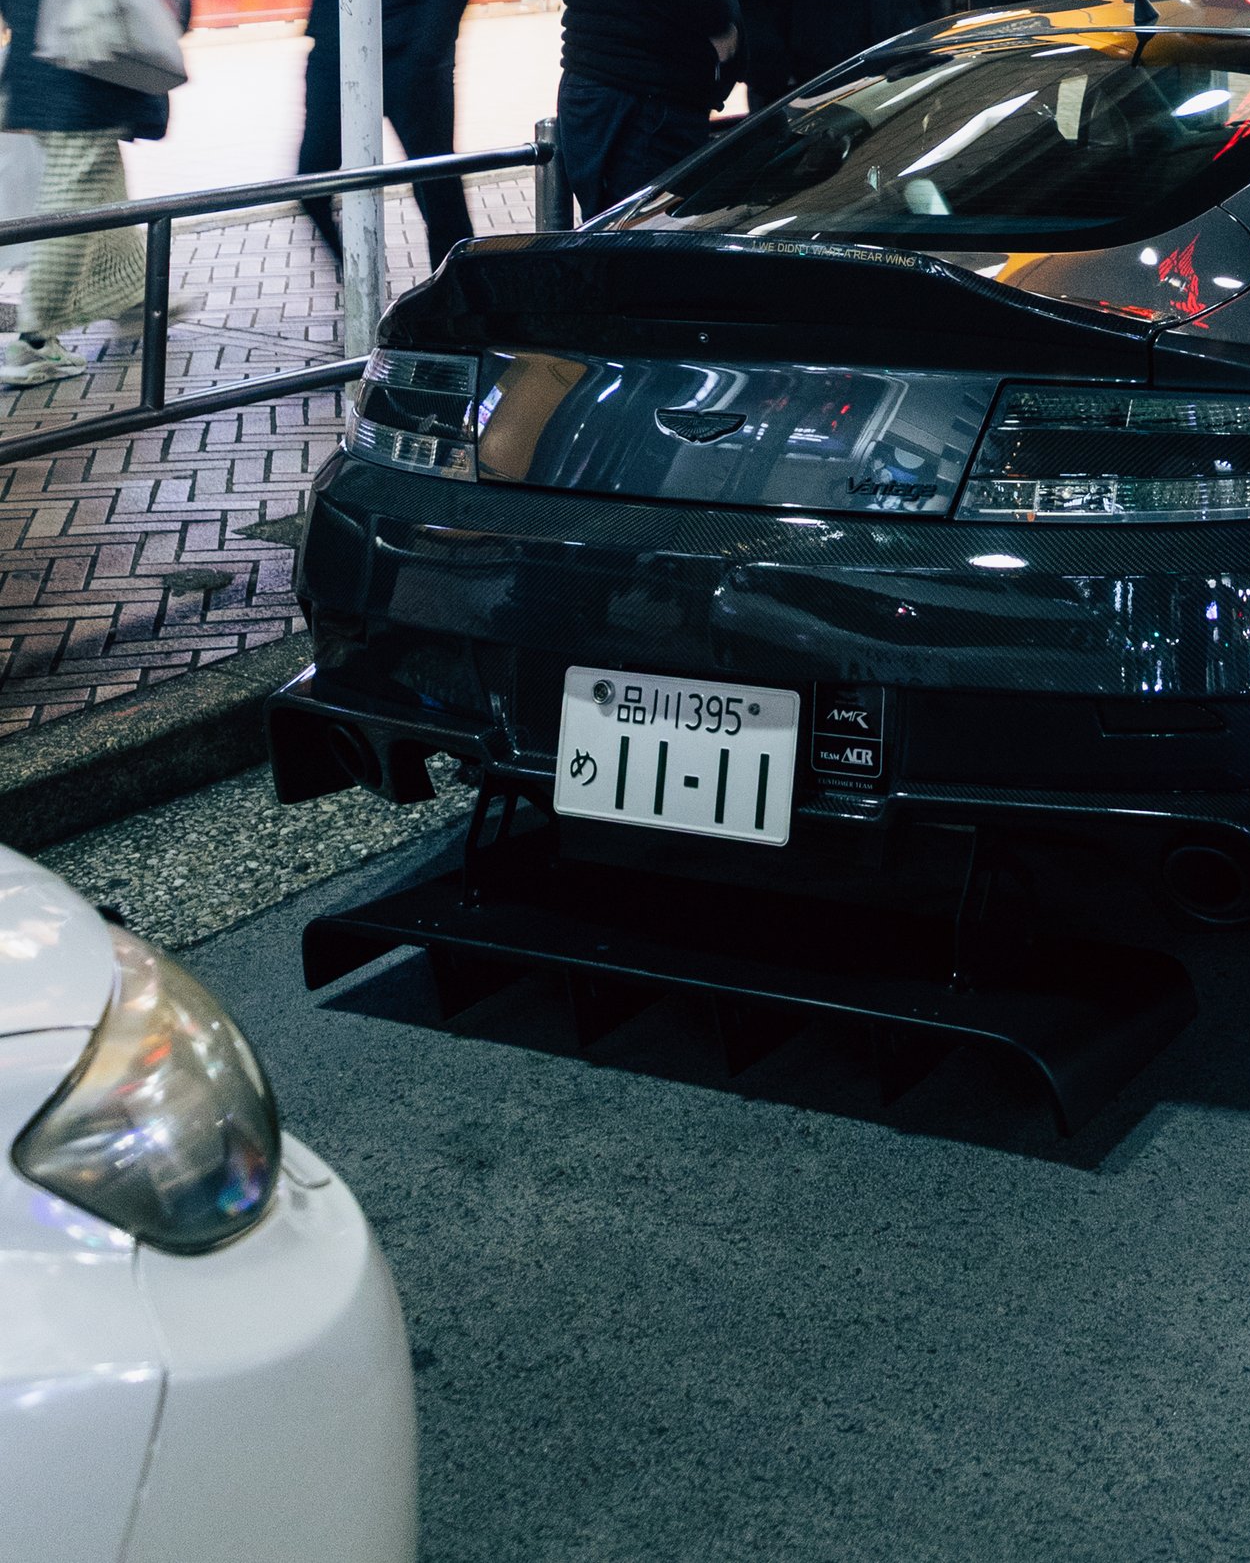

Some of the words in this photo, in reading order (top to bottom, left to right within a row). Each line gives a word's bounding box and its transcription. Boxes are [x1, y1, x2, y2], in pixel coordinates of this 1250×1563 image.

[759, 242, 775, 252] WE
[854, 250, 883, 262] REAR
[886, 254, 916, 267] WING
[846, 476, 938, 502] Vantage
[826, 708, 869, 730] AMR
[820, 751, 840, 761] TEAM
[841, 747, 873, 767] ACR
[570, 748, 598, 786] め
[614, 735, 770, 830] 11-11
[818, 778, 854, 788] CUSTOMER
[855, 781, 873, 790] TEAM
